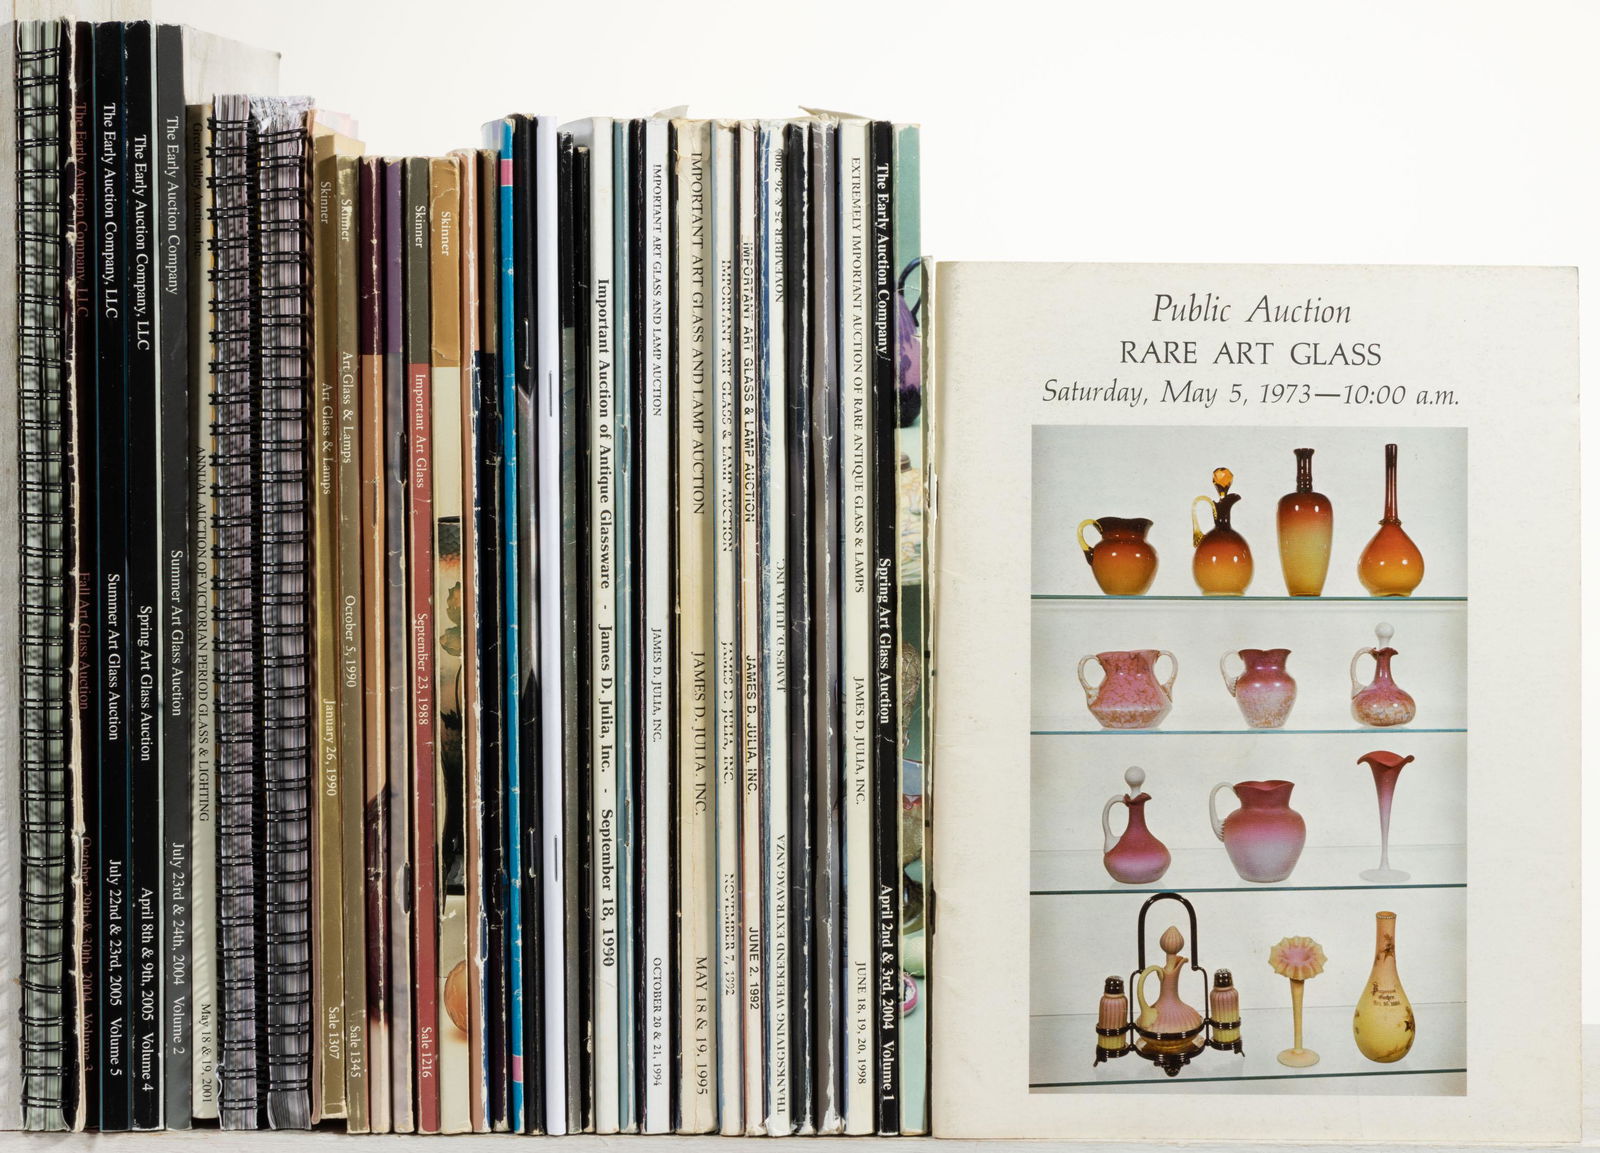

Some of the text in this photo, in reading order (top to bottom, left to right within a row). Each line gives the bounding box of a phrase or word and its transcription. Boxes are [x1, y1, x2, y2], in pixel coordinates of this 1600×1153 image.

[101, 102, 118, 318] The Early Auction Company, LLC
[164, 116, 180, 295] The Early Auction Company
[320, 181, 331, 224] Skinner
[415, 205, 426, 248] Skinner
[441, 211, 451, 256] Skinner
[653, 164, 662, 416] IMPORTANT ART GLASS AND LAMP AUCTION
[874, 163, 890, 354] The Early Auction Company
[1152, 293, 1350, 323] Public Auction
[852, 158, 864, 593] EXTREMELY IMPORTANT AUCTION OF RARE ANTIQUE GLASS & LAMPS
[1120, 341, 1381, 366] RARE ART GLASS
[340, 351, 354, 463] Art Glass & Lamps
[1042, 378, 1148, 408] Saturday,
[1160, 380, 1218, 408] May
[1229, 384, 1247, 406] 5,
[1416, 390, 1458, 405] a.m.
[319, 382, 333, 496] Art Glass & Lamps
[412, 374, 427, 489] Important Art Glass
[108, 574, 121, 740] Summer Art Glass Auction
[171, 550, 184, 716] Summer Art Glass Auction
[196, 445, 208, 821] ANNUAL AUCTION OF VICTORIAN PERIOD GLASS & LIGHTING
[344, 595, 357, 688] October 5, 1990
[595, 279, 617, 967] Important Auction of Antique Glassware James D. Julia, Inc. September 18, 1990
[878, 558, 892, 724] Spring Art Glass Auction
[414, 612, 429, 727] September 23, 1988
[651, 628, 662, 742] JAMES D. JULIA, INC.
[323, 698, 337, 796] January 26, 1990
[853, 677, 865, 805] JAMES D. JULIA, INC.
[106, 859, 122, 885] July
[109, 889, 122, 920] 22nd
[880, 883, 893, 919] April
[109, 924, 122, 936] &
[109, 940, 122, 971] 23rd,
[170, 842, 185, 1055] July 23rd & 24th, 2004 Volume 2
[749, 926, 760, 961] JUNE
[880, 923, 893, 947] 2nd
[880, 952, 894, 964] &
[110, 975, 122, 1006] 2005
[750, 982, 760, 1010] 1992
[776, 835, 786, 1114] THANKSGIVING WEEKEND EXTRAVAGANZA
[880, 967, 894, 997] 3rd,
[110, 1017, 122, 1065] Volume
[329, 1006, 340, 1059] Sale 1307
[652, 957, 662, 1086] OCTOBER 20 & 21, 1994
[855, 961, 866, 1084] JUNE 18, 19, 20, 1998
[880, 998, 894, 1030] 2004
[199, 1004, 214, 1102] May 18 & 19, 2001
[350, 1025, 361, 1078] Sale 1345
[419, 1027, 432, 1079] Sale 1216
[880, 1040, 894, 1090] Volume
